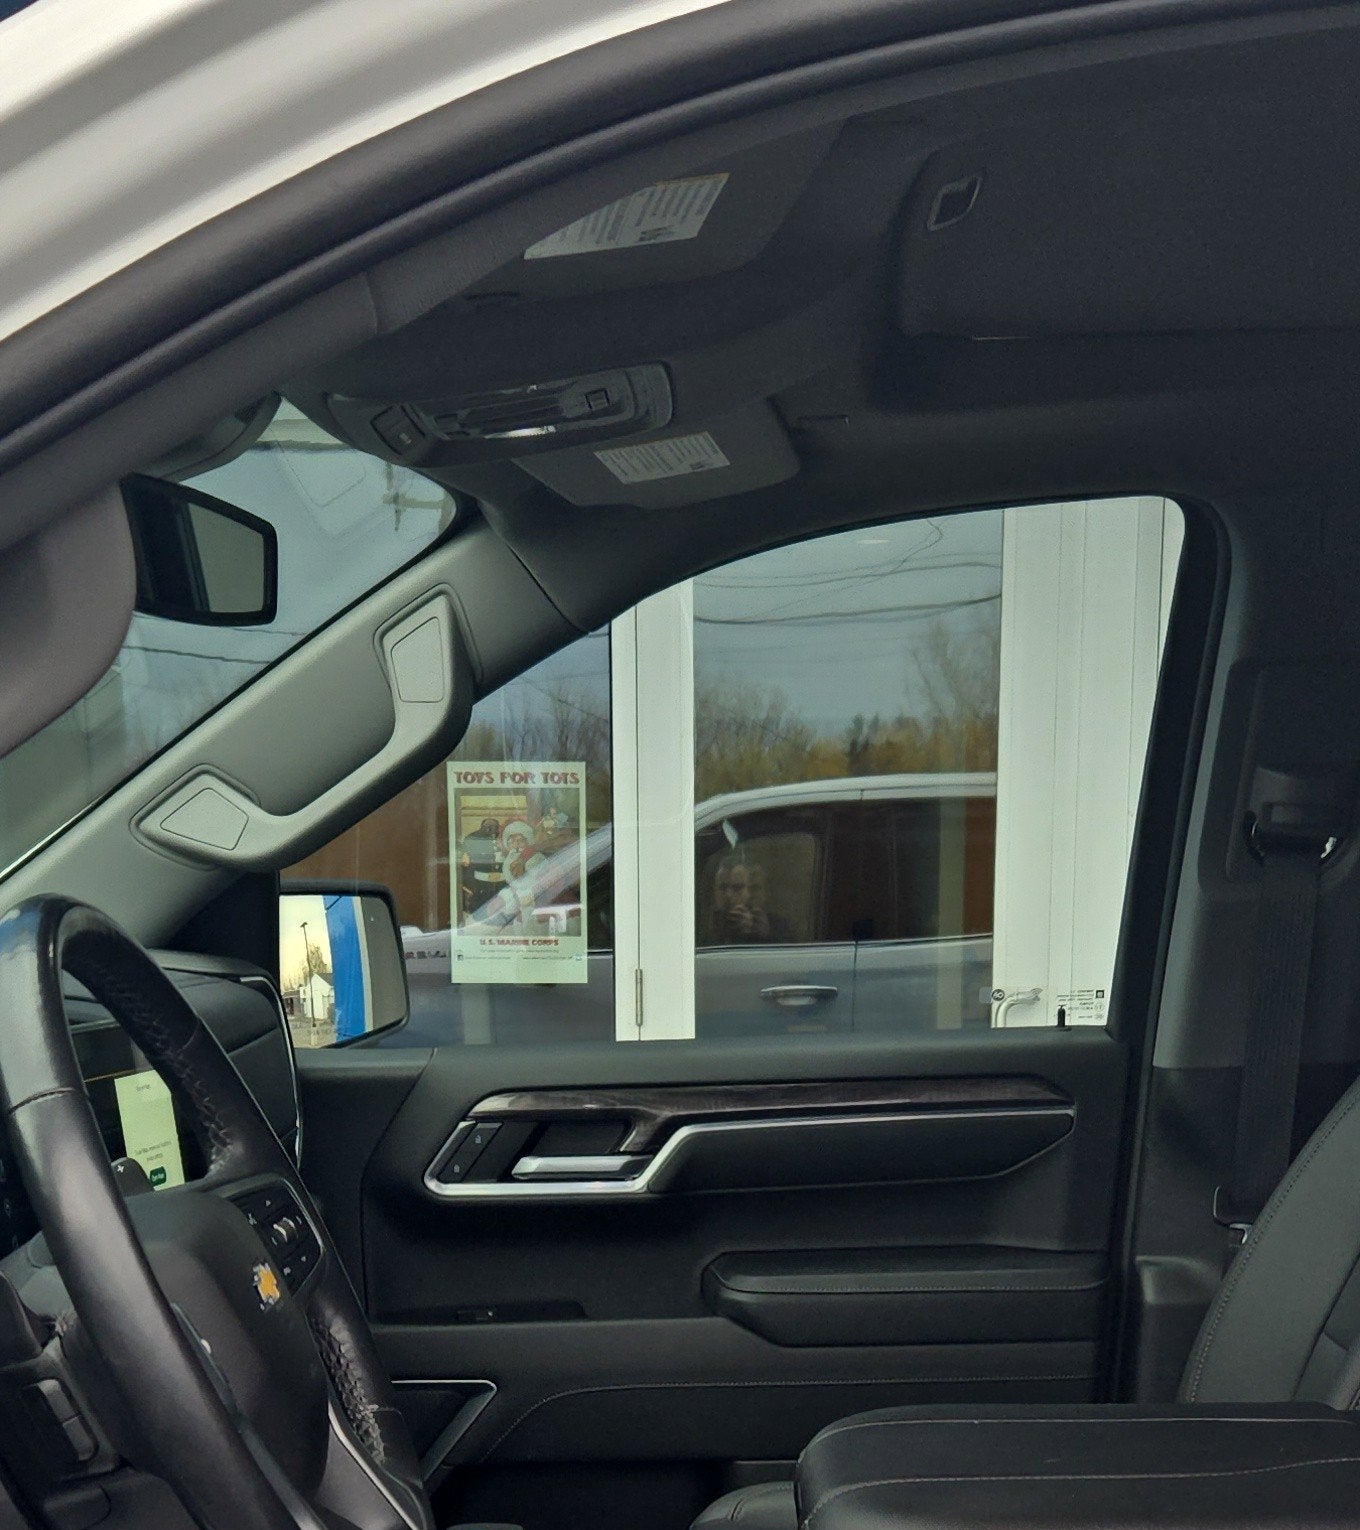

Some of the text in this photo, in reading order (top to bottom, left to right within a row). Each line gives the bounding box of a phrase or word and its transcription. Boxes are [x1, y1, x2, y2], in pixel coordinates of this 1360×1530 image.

[453, 771, 580, 784] TOYS FOR TOTS
[497, 938, 529, 946] MARINE
[531, 938, 559, 946] CORPS
